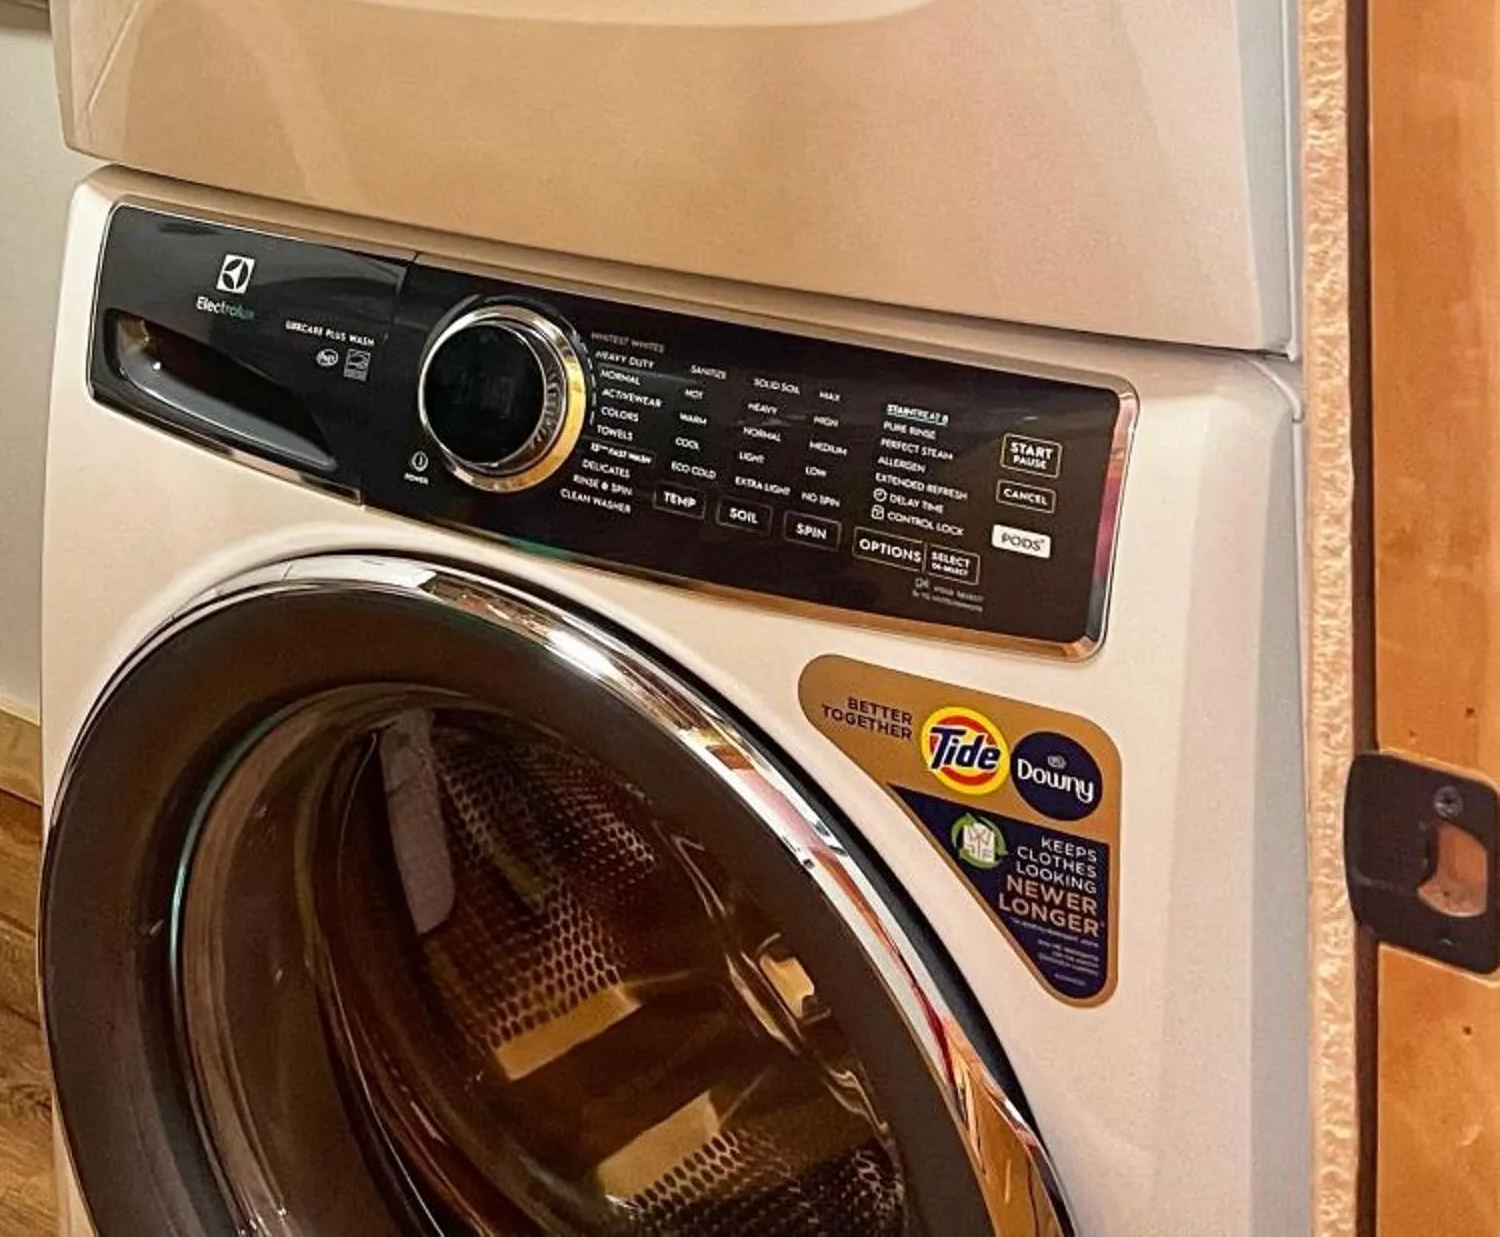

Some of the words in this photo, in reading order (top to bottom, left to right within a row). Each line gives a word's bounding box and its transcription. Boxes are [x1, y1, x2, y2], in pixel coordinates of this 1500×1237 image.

[196, 296, 255, 321] Electrolux
[595, 350, 627, 363] HEAVY
[628, 356, 655, 369] DUTY
[601, 369, 641, 386] NORMAL
[691, 364, 727, 380] SANITIZE
[602, 388, 663, 408] ACTIVEWEAR
[601, 406, 640, 423] COLORS
[747, 402, 778, 415] HEAVY
[679, 412, 708, 426] WARM
[596, 424, 633, 441] TOWELS
[742, 426, 782, 443] NORMAL
[883, 420, 907, 434] PURE
[909, 425, 937, 440] RINSE
[738, 450, 765, 464] LIGHT
[809, 440, 848, 457] MEDIUM
[881, 438, 920, 454] PERFECT
[921, 446, 954, 460] STEAM
[1011, 440, 1054, 461] START
[581, 458, 631, 479] DELICATES
[671, 460, 690, 474] ECO
[691, 465, 717, 480] COLD
[805, 466, 827, 478] LOW
[877, 456, 927, 474] ALLERGEN
[1013, 454, 1048, 470] PAUSE
[573, 474, 599, 490] RINSE
[611, 482, 633, 496] SPIN
[735, 476, 763, 490] EXTRA
[764, 483, 791, 496] LIGHT
[875, 472, 925, 492] EXTENDED
[926, 483, 969, 501] REFRESH
[560, 488, 591, 503] CLEAN
[592, 496, 631, 515] WASHER
[663, 490, 697, 508] TEMP
[801, 491, 818, 503] NO
[819, 494, 841, 508] SPIN
[889, 493, 920, 508] DELAY
[921, 500, 944, 514] TIME
[1003, 488, 1048, 506] CANCEL
[729, 506, 759, 524] SOIL
[887, 511, 935, 531] CONTROL
[936, 521, 964, 537] LOCK
[795, 523, 827, 540] SPIN
[859, 538, 923, 564] OPTIONS
[931, 551, 970, 569] SELECT
[848, 696, 913, 726] BETTER
[821, 704, 913, 741] TOGETHER
[927, 725, 1002, 771] Tide
[1017, 757, 1095, 804] Downy
[1041, 836, 1098, 863] KEEPS
[1017, 846, 1098, 879] CLOTHES
[1016, 862, 1098, 895] LOOKING
[1006, 874, 1098, 917] NEWER
